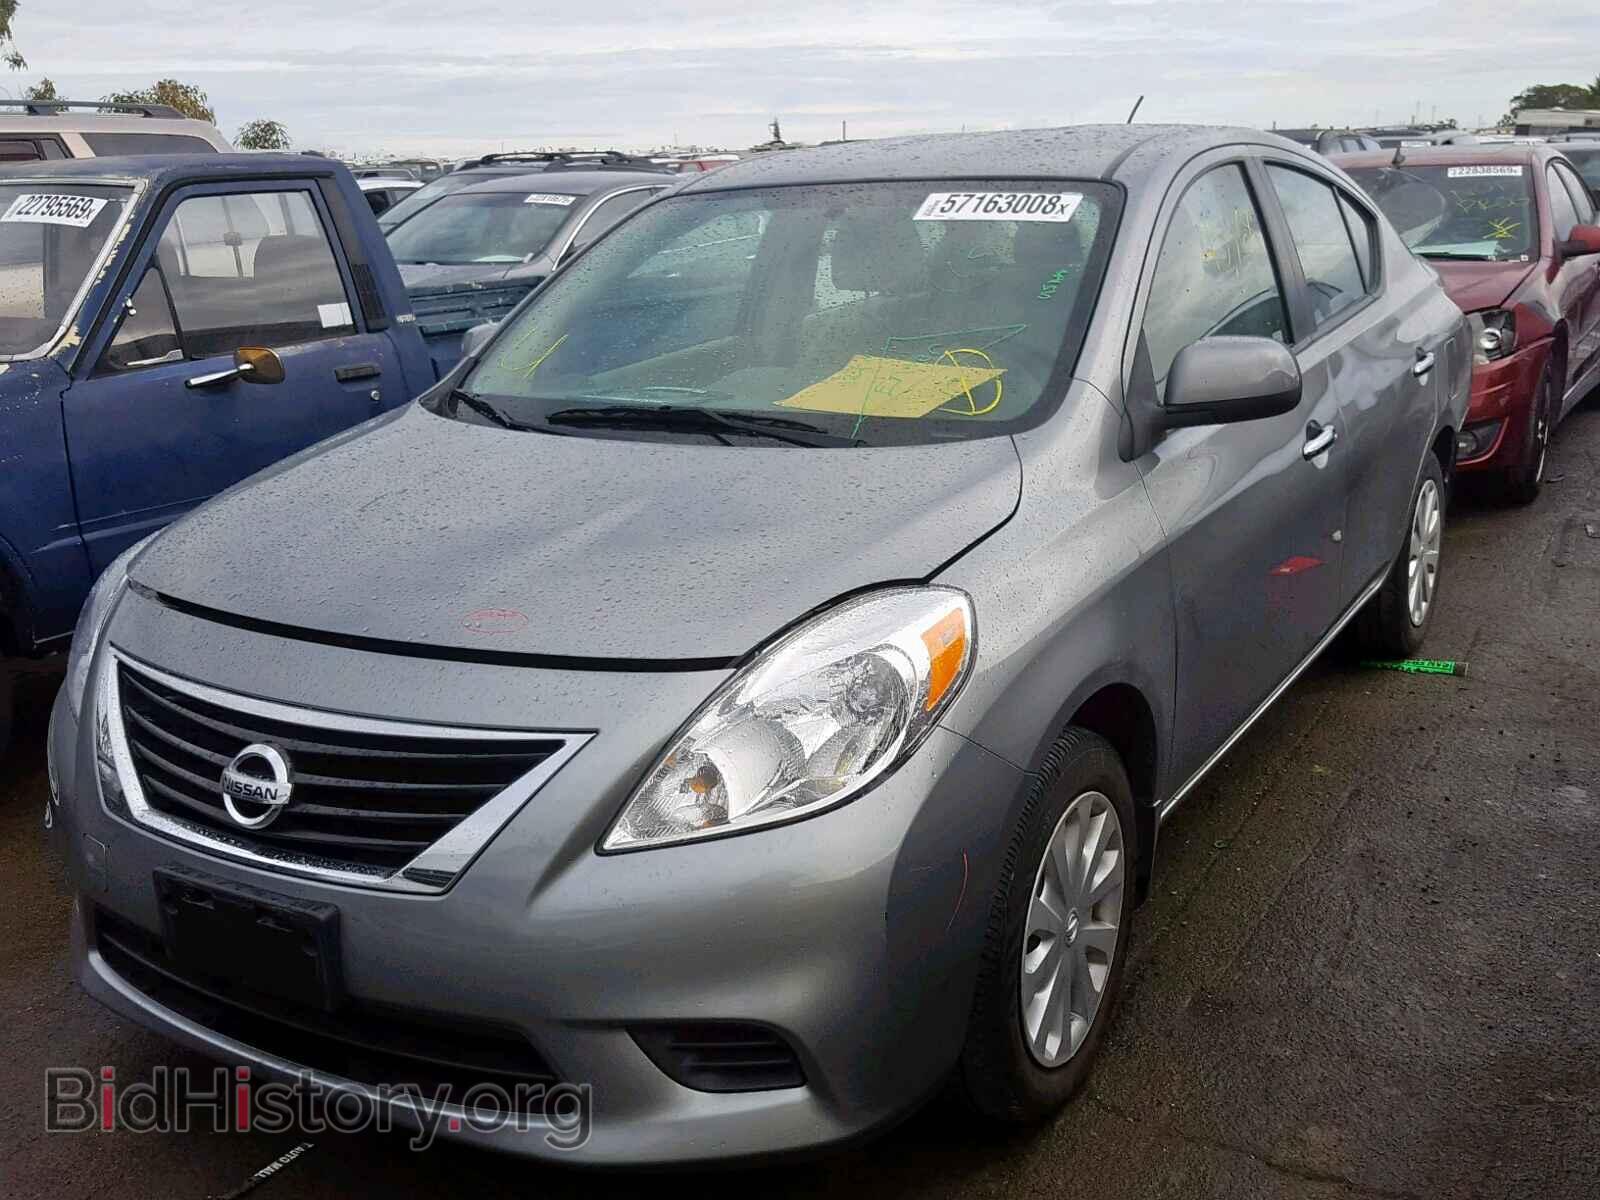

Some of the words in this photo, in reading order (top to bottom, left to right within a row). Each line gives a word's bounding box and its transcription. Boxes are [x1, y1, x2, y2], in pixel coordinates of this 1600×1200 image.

[223, 774, 279, 801] NISSAN
[279, 1146, 305, 1164] AUTO
[253, 1161, 283, 1178] MALL
